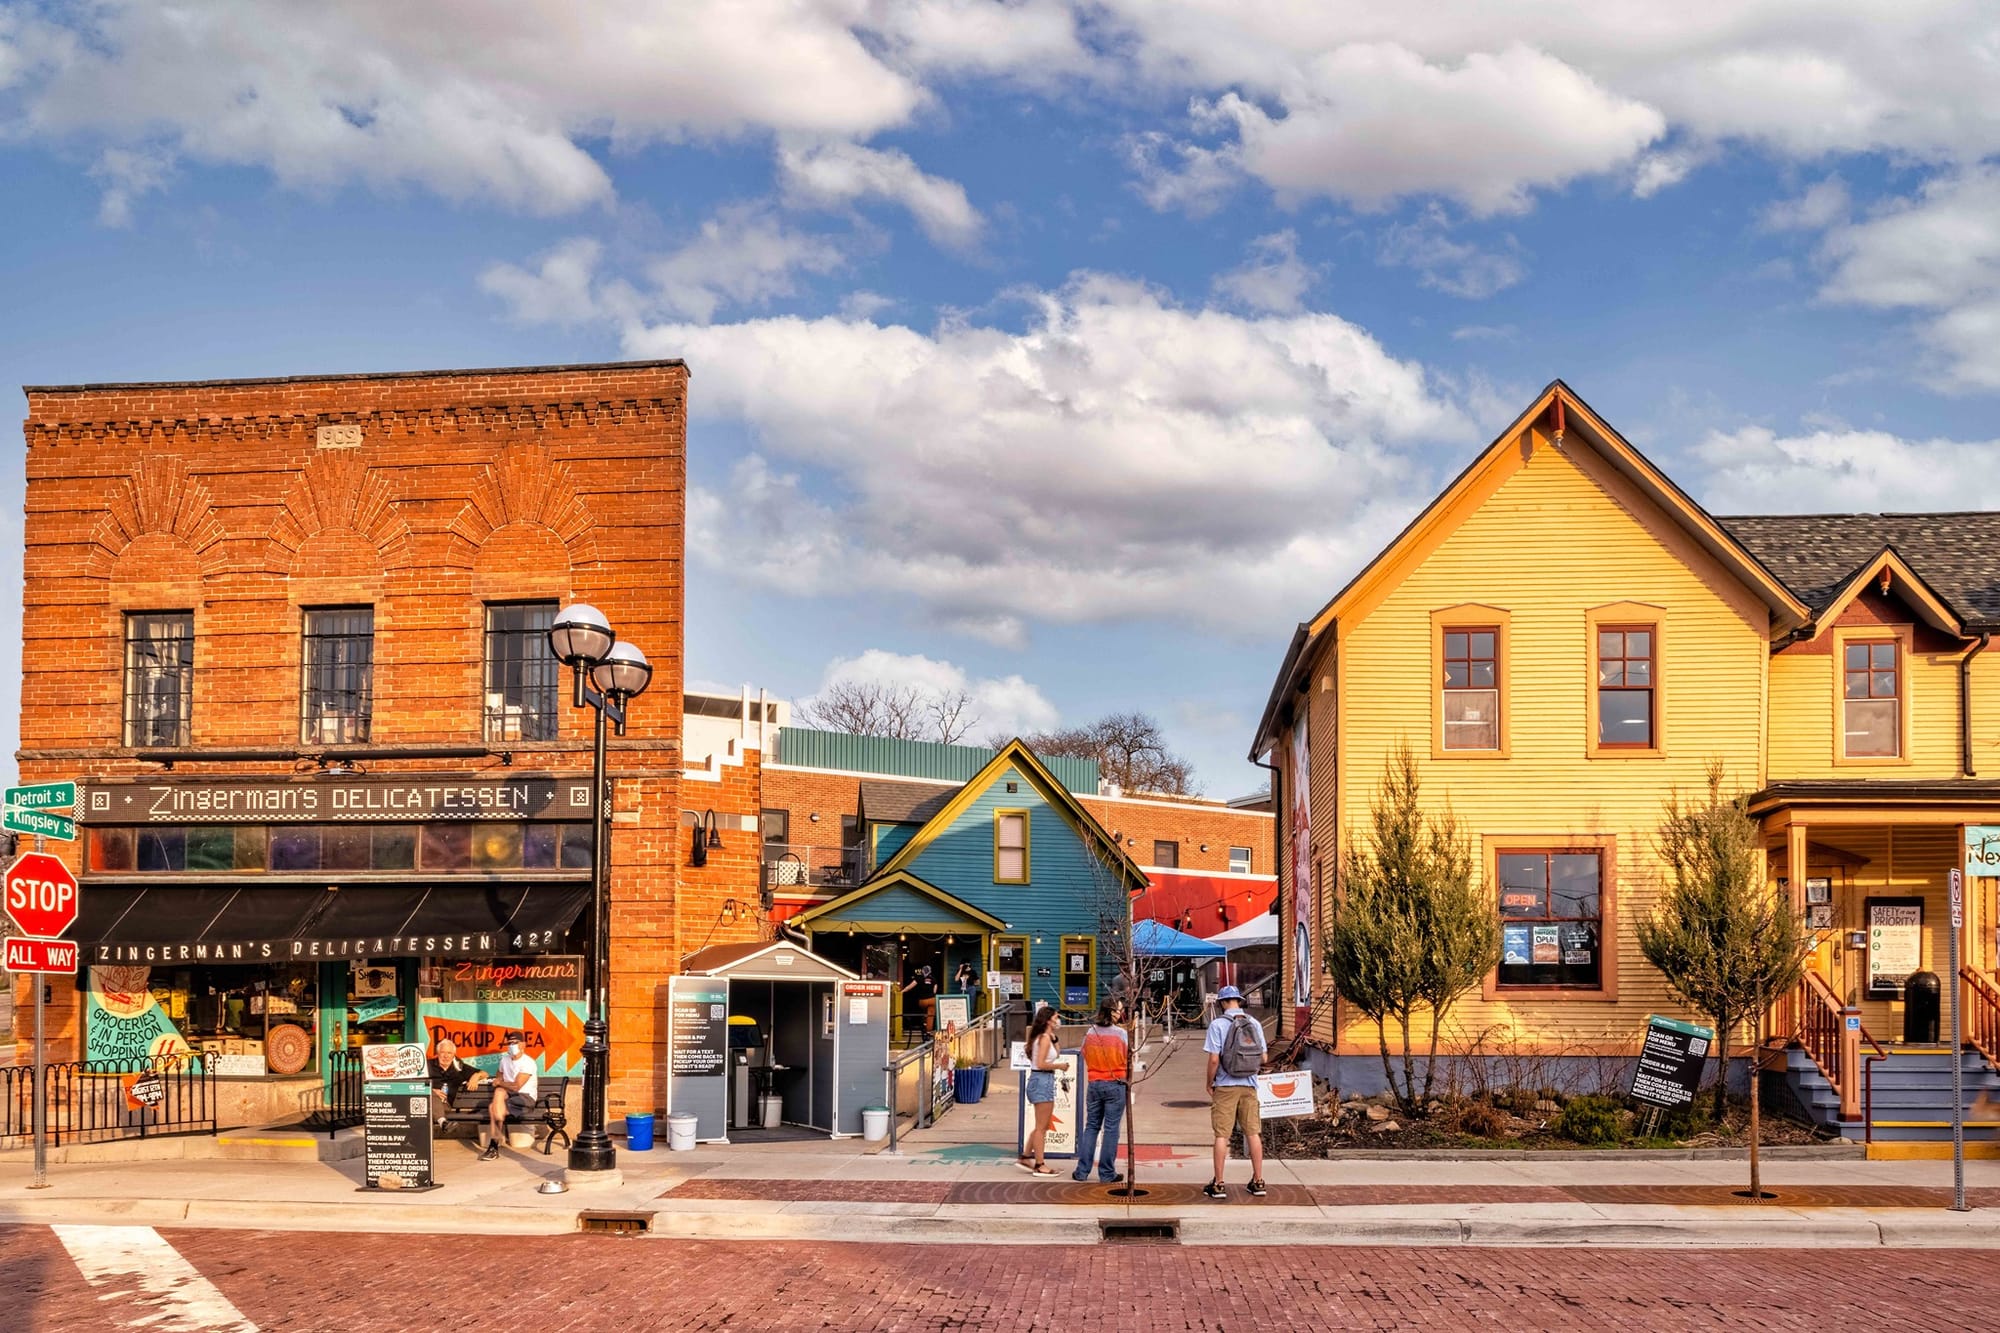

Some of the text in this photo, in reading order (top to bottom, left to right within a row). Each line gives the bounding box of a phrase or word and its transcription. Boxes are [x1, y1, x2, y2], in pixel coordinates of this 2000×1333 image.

[14, 790, 66, 805] Detroit St
[149, 785, 529, 815] Zingerman's DELICATESSEN
[14, 811, 60, 834] Kingsley
[63, 822, 73, 834] St
[10, 877, 73, 913] STOP
[1504, 894, 1537, 906] OPEN
[1873, 907, 1900, 917] SAFETY
[1874, 916, 1916, 926] PRIORITY
[9, 945, 37, 965] ALL
[47, 947, 73, 967] WAY
[101, 942, 271, 961] ZINGERMAN'S
[294, 936, 490, 956] DELICATESSEN
[513, 930, 552, 948] 422
[455, 962, 578, 987] Zingerman's
[477, 989, 556, 1001] DELICATESSEN
[93, 1008, 157, 1031] GROCERIES
[98, 1027, 112, 1042] IN
[115, 1022, 163, 1046] PERSON
[430, 1024, 495, 1056] PICKUP
[1659, 1038, 1677, 1047] MENU
[88, 1038, 147, 1060] SHOPPING
[412, 1049, 421, 1058] TO
[1665, 1064, 1678, 1072] PAY
[1637, 1072, 1652, 1081] WAIT
[1651, 1076, 1664, 1084] FOR
[1667, 1080, 1684, 1089] TEXT
